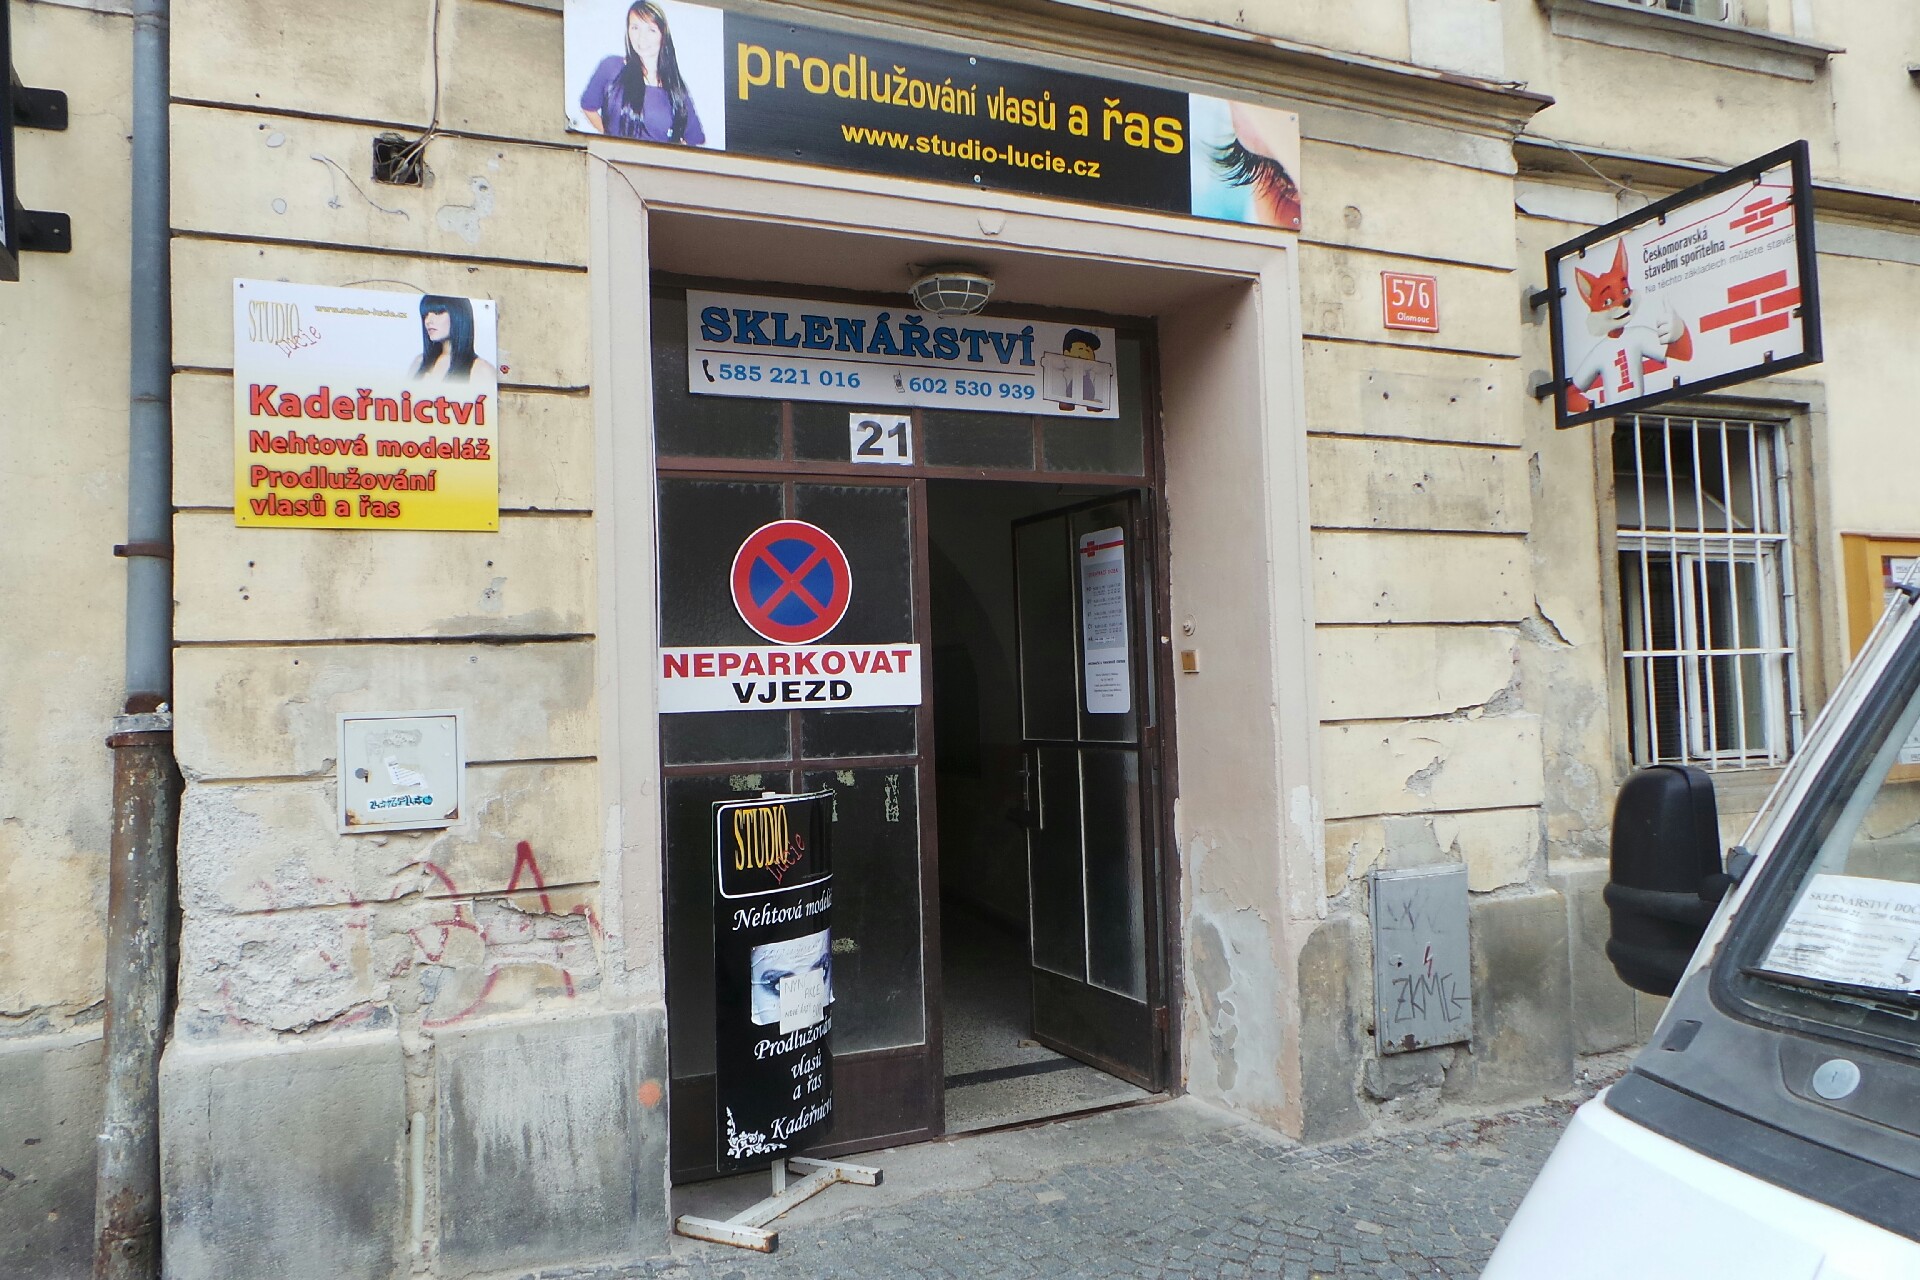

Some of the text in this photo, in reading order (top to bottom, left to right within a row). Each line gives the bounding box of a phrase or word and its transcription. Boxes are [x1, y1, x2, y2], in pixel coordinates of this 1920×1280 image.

[737, 41, 1185, 155] prodlužování vlasů a řas
[841, 121, 1101, 179] www.studio-lucie.cz
[1643, 225, 1708, 264] Českomoravská
[1644, 240, 1725, 280] stavební spořitelna
[1392, 279, 1430, 309] 576
[1644, 284, 1656, 294] Na
[1684, 257, 1727, 281] základech
[249, 300, 300, 343] STUDIO
[1397, 311, 1430, 324] Olomouc
[700, 305, 1036, 368] SKLENÁŘSTVÍ
[718, 364, 1036, 401] 585 221 016 602 530 939
[249, 384, 487, 426] Kadeřnictví
[249, 430, 491, 460] Nehtová modeláž
[856, 419, 910, 457] 21
[250, 464, 437, 492] Prodlužování
[250, 493, 401, 518] vlasů a řas
[662, 650, 913, 679] NEPARKOVAT
[731, 679, 854, 704] VJEZD
[734, 804, 790, 871] STUDIO
[732, 899, 803, 931] Nehtová
[790, 1047, 822, 1080] vlasů
[792, 1072, 823, 1101] a řas
